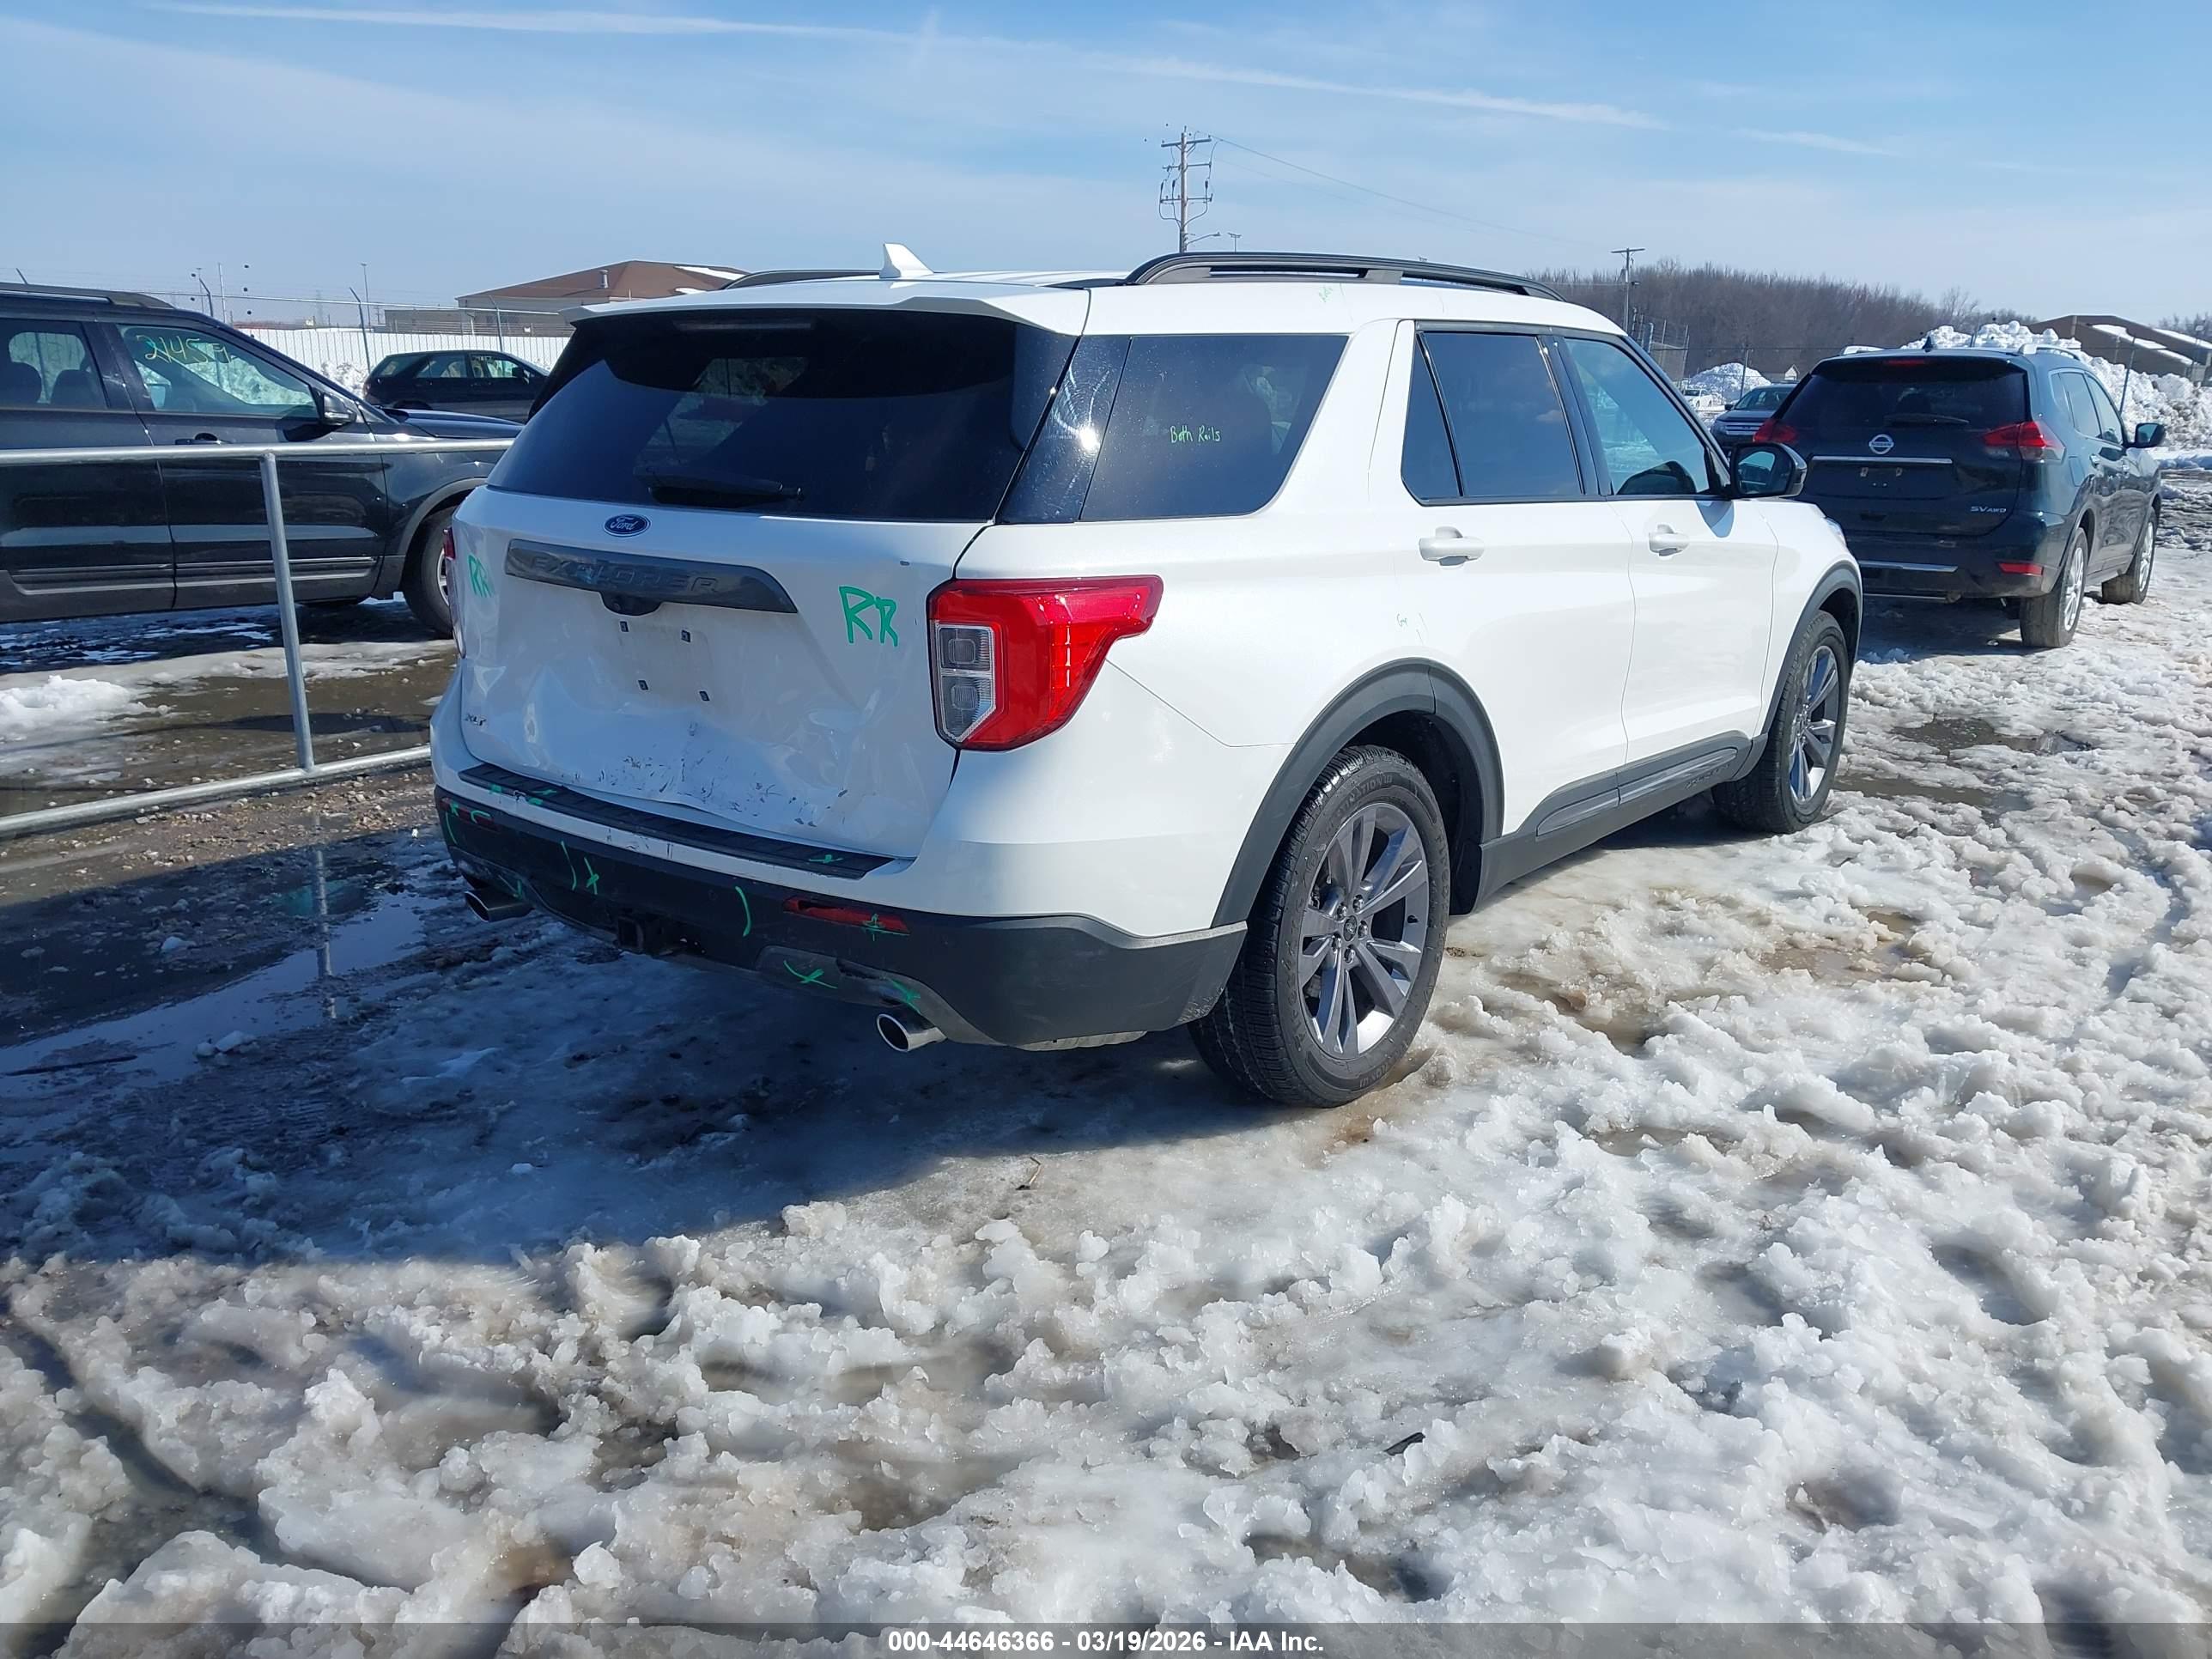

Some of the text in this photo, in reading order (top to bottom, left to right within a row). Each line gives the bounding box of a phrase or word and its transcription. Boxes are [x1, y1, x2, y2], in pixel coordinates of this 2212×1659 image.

[1170, 424, 1221, 443] Both Rails
[838, 586, 899, 647] RR
